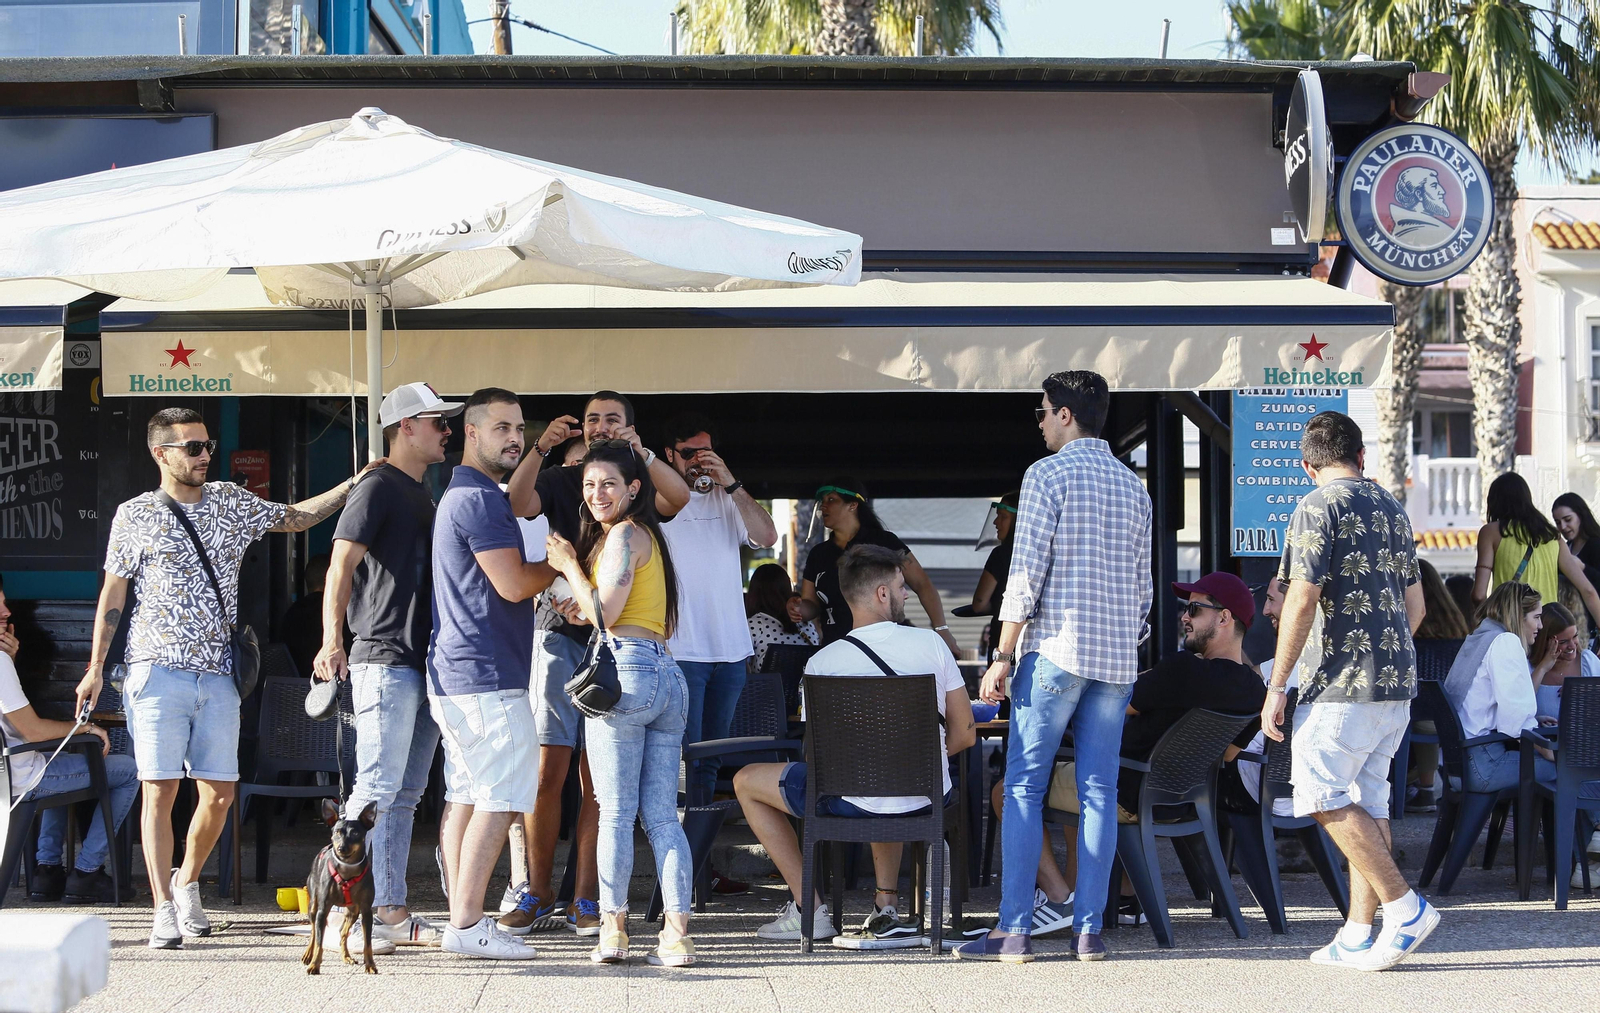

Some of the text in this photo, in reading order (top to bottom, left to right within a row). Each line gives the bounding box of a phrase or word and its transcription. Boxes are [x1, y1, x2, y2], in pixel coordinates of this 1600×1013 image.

[1352, 135, 1478, 194] PAULANER
[1366, 228, 1474, 269] MÜNCHEN
[787, 252, 843, 274] GUINNESS
[72, 350, 89, 358] VOX
[129, 374, 233, 392] Heineken
[1263, 367, 1364, 385] Heineken
[1261, 404, 1316, 413] ZUMOS
[1255, 422, 1306, 431] BATID
[1252, 458, 1301, 467] COCTE
[28, 469, 63, 496] the
[1234, 528, 1279, 552] PARA
